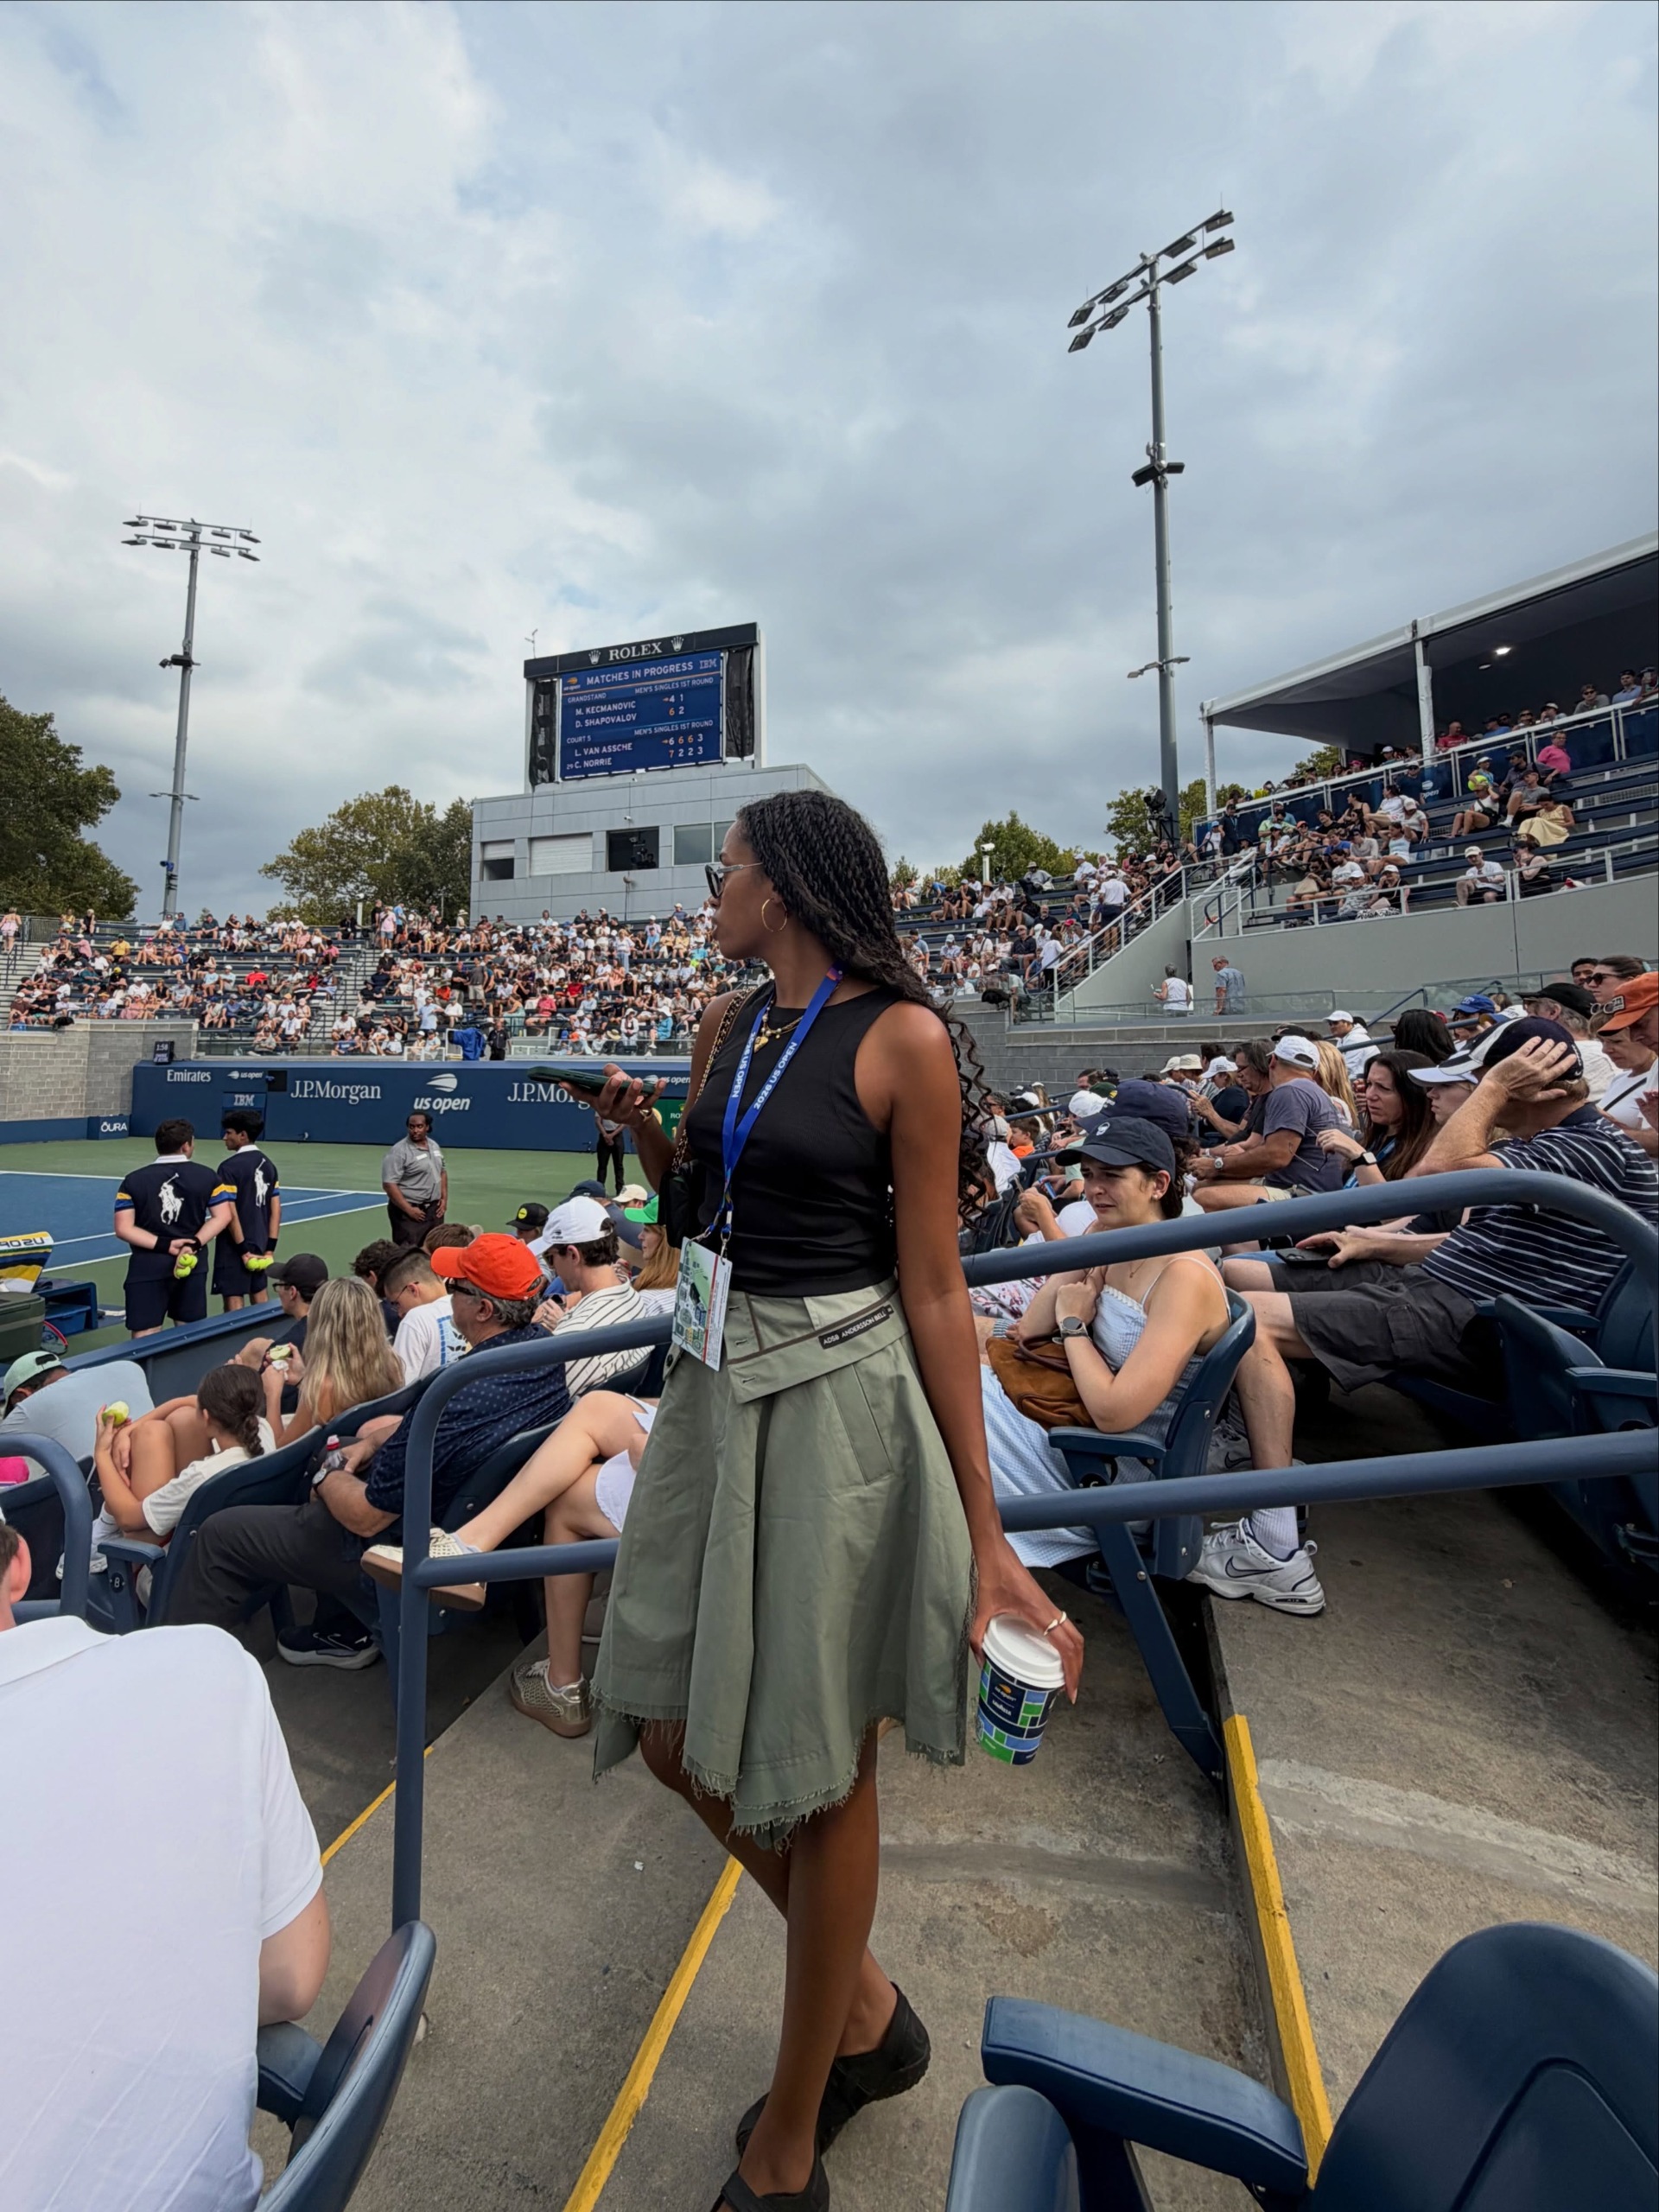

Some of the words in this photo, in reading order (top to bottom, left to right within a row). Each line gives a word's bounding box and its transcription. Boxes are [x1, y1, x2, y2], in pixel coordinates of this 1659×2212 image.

[608, 642, 663, 661] ROLEX
[587, 671, 630, 685] MATCHES
[632, 669, 641, 679] IN
[644, 662, 694, 677] PROGRESS
[699, 658, 718, 670] IBM
[635, 685, 653, 694] MEN'S
[654, 681, 679, 691] SINGLES
[691, 677, 714, 686] ROUND
[567, 692, 607, 704] GRANDSTAND
[575, 708, 584, 716] M.
[585, 701, 636, 715] KECMANOVIC
[679, 693, 683, 702] 1
[584, 713, 638, 727] SHAPOVALOV
[678, 706, 684, 715] 2
[653, 724, 679, 734] SINGLES
[691, 720, 713, 728] ROUND
[566, 735, 586, 744] COURT
[583, 747, 600, 756] VAN
[601, 742, 633, 753] ASSCHE
[669, 737, 675, 746] 6
[677, 735, 684, 744] 6
[687, 734, 694, 743] 6
[697, 734, 703, 742] 3
[583, 757, 613, 768] NORRIE
[669, 750, 674, 759] 7
[677, 748, 684, 757] 2
[688, 747, 694, 756] 2
[697, 747, 703, 755] 3
[740, 1056, 749, 1070] US
[167, 1069, 212, 1083] Emirates
[731, 1070, 745, 1098] OPEN
[753, 1084, 772, 1110] 2026
[769, 1069, 781, 1084] US
[778, 1041, 798, 1070] OPEN
[233, 1094, 255, 1107] IBM
[290, 1080, 382, 1105] J.P.Morgan
[506, 1082, 591, 1110] J.P.Mo
[413, 1096, 432, 1110] us
[432, 1097, 471, 1115] open
[842, 1318, 874, 1338] ANDERSSON
[874, 1311, 887, 1321] BELL
[114, 1576, 120, 1588] 8
